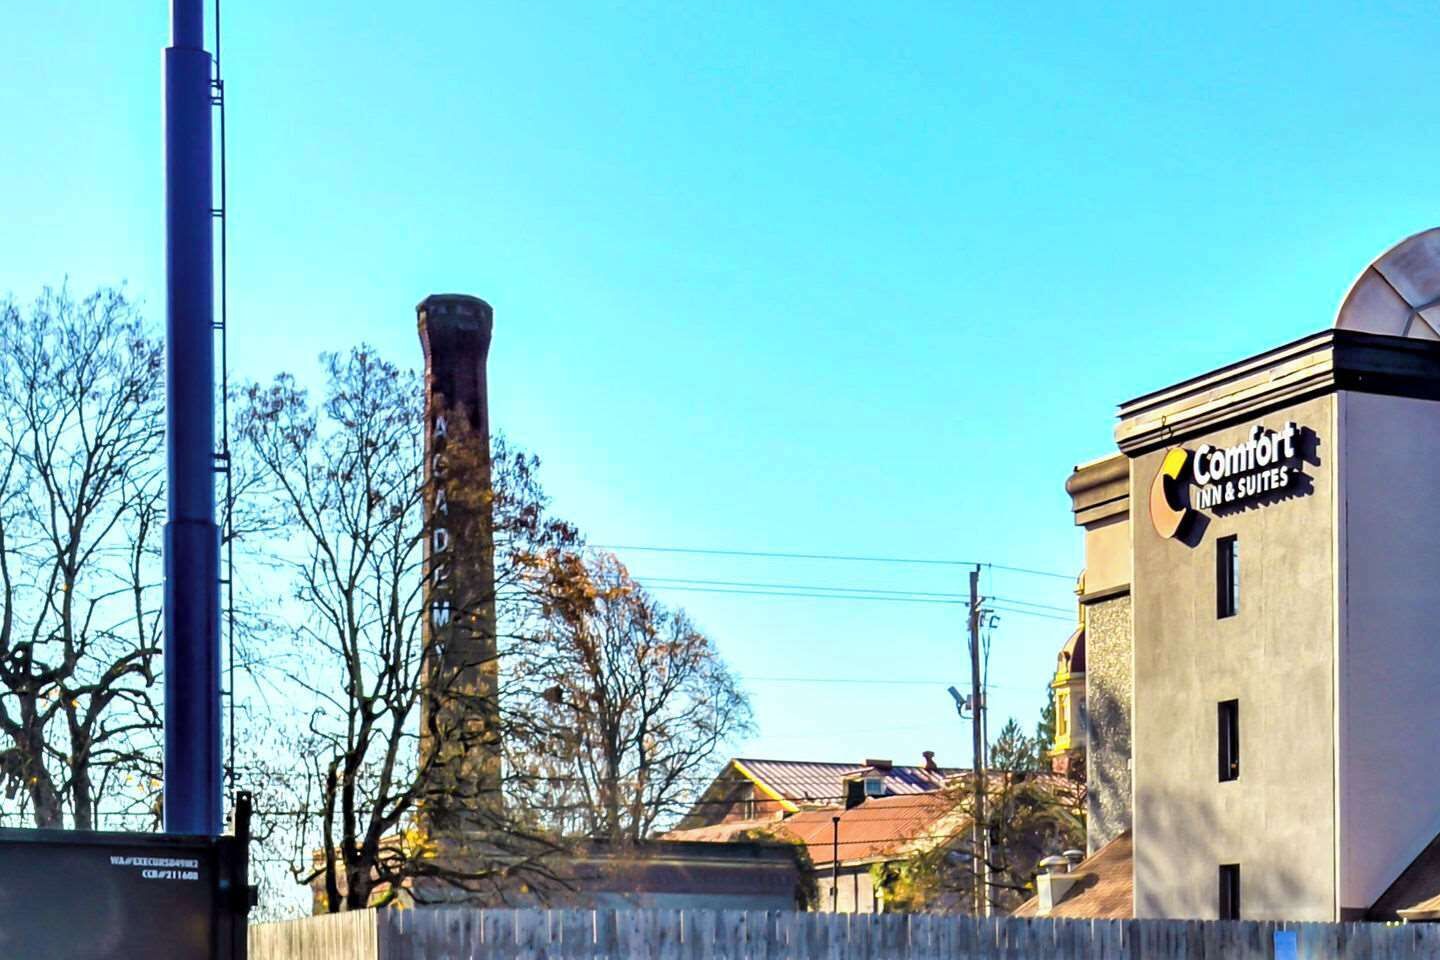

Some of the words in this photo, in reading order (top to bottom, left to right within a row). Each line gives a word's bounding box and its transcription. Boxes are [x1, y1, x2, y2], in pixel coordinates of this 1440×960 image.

[1193, 421, 1295, 486] Comfort
[1196, 484, 1222, 510] INN
[1224, 481, 1236, 502] &
[1237, 465, 1289, 499] SUITES
